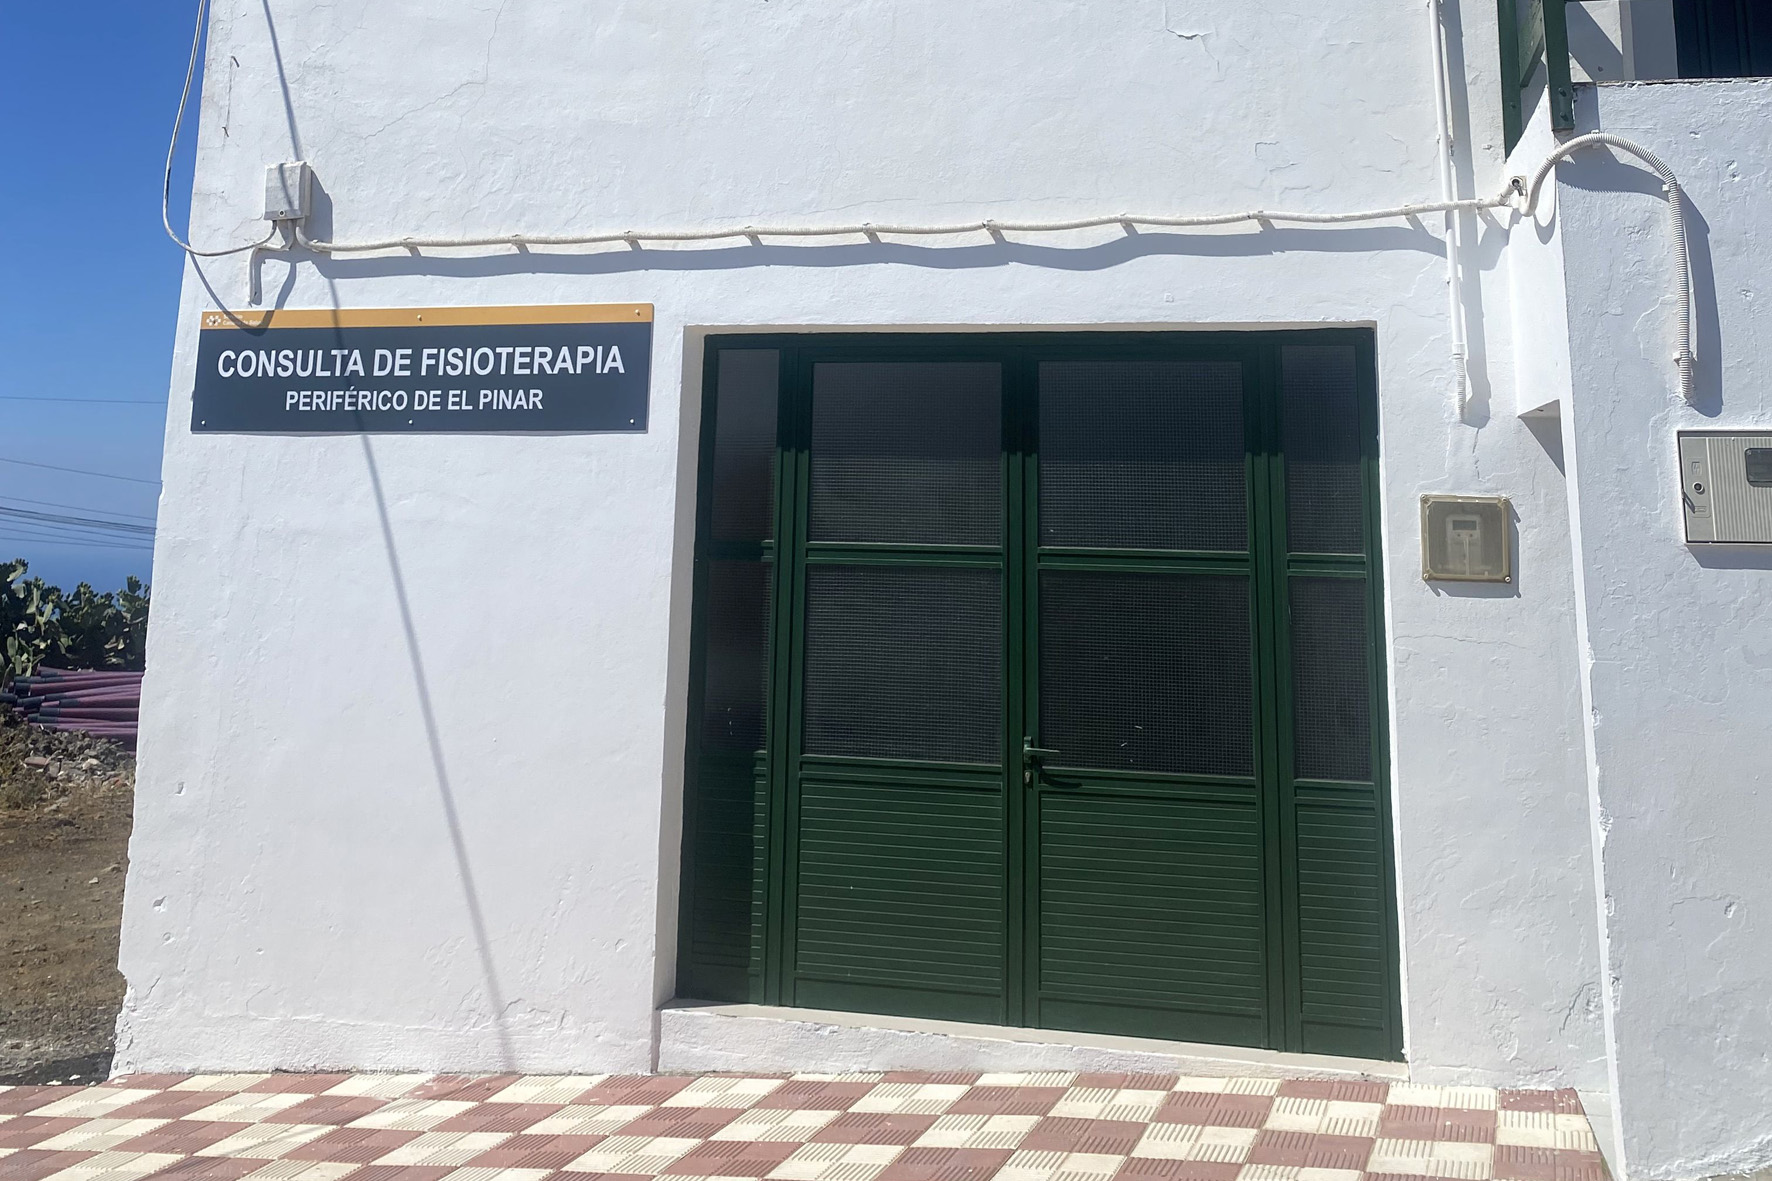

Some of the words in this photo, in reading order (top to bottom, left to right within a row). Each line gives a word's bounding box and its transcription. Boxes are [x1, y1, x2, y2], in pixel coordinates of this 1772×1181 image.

[217, 349, 365, 378] CONSULTA
[372, 348, 413, 377] DE
[420, 345, 626, 376] FISIOTERAPIA
[285, 385, 408, 411] PERIFÉRICO
[413, 390, 442, 411] DE
[447, 389, 474, 410] EL
[478, 389, 544, 410] PINAR
